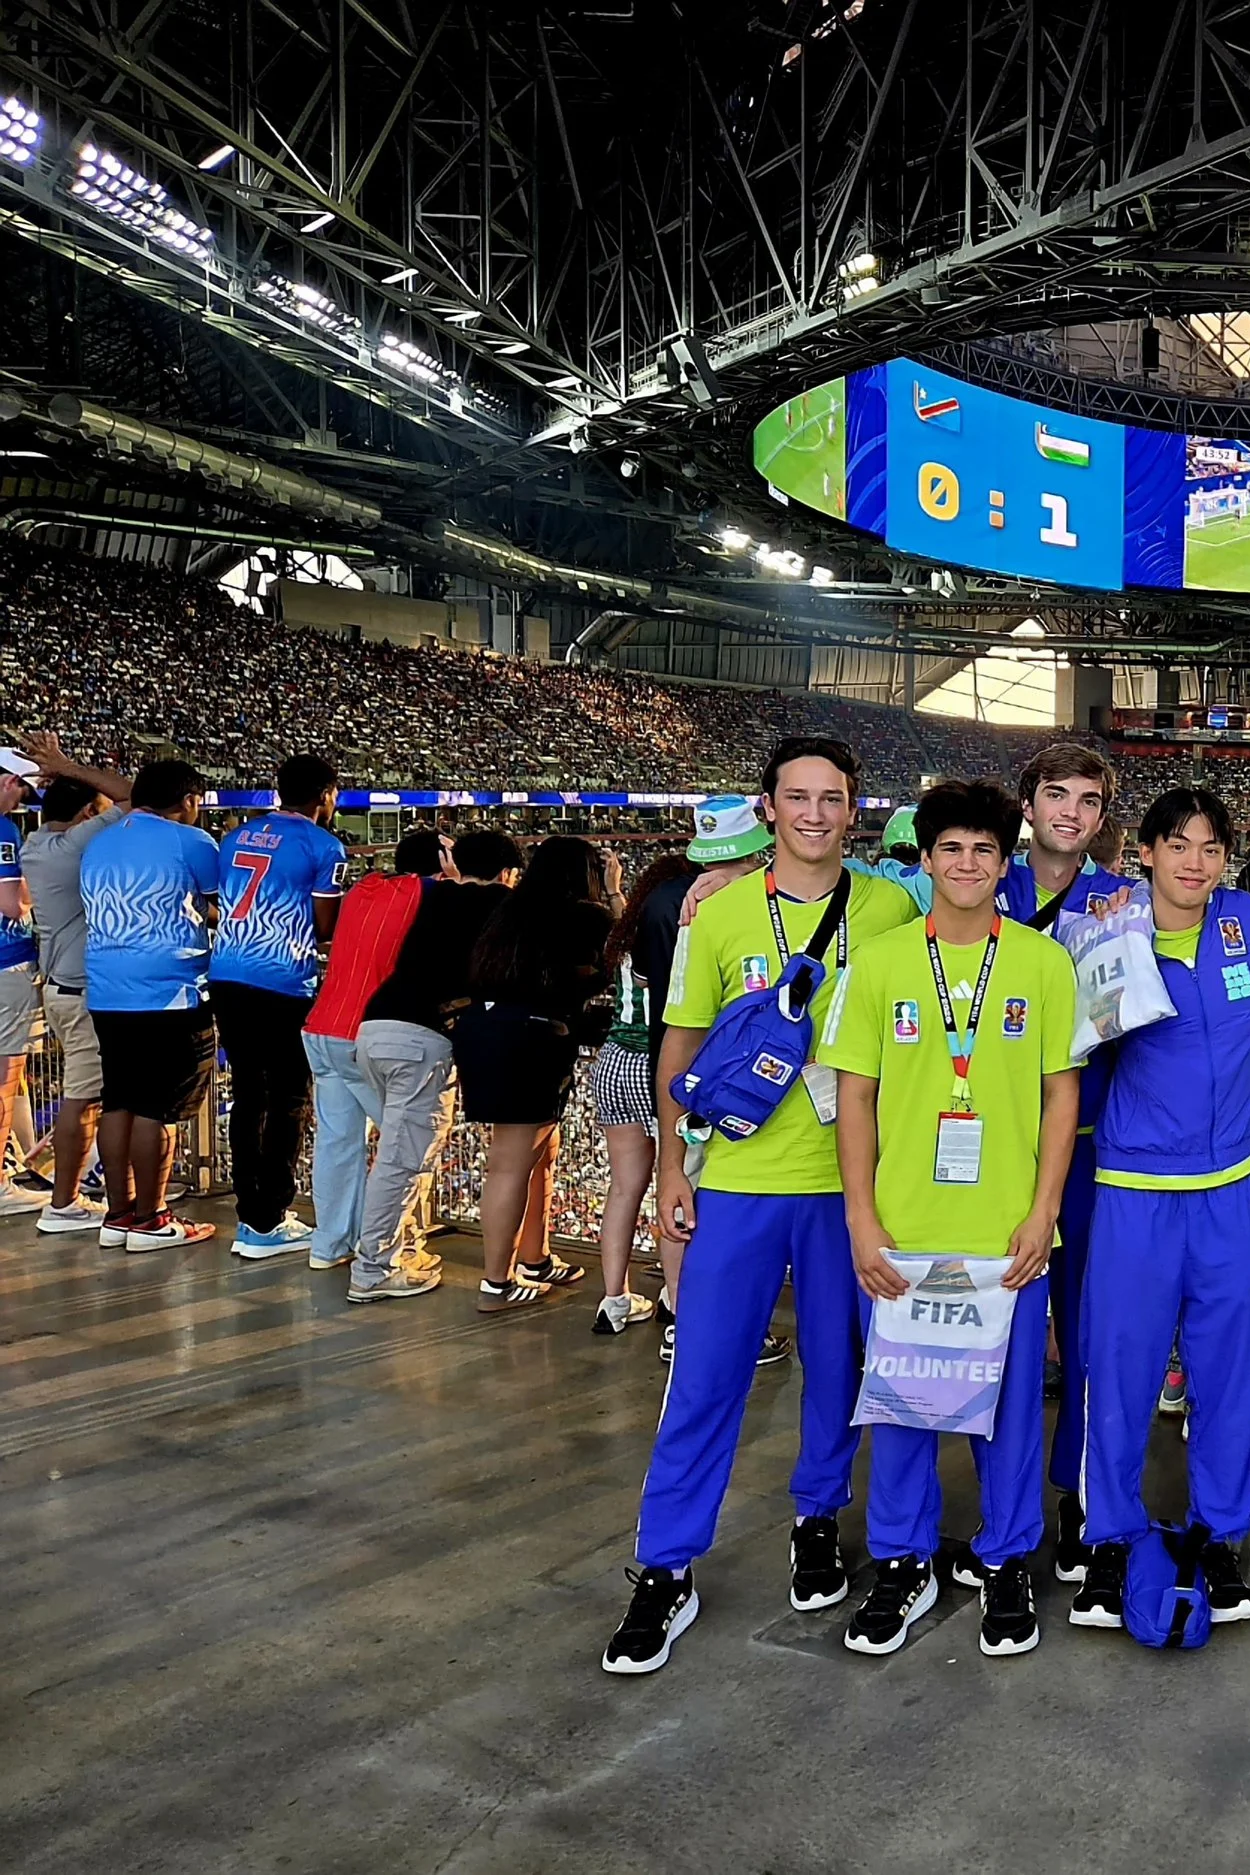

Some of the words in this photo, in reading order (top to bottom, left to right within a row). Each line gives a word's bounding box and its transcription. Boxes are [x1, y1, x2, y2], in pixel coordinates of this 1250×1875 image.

[1201, 450, 1230, 459] 43:52
[918, 461, 960, 521] 0
[1040, 492, 1077, 547] 1
[229, 851, 272, 921] 7
[772, 914, 783, 938] WORLD
[933, 958, 943, 983] WORLD
[938, 984, 946, 998] CUP
[970, 1006, 980, 1022] FIFA
[975, 980, 986, 1005] WORLD
[981, 966, 989, 980] CUP
[911, 1298, 983, 1327] FIFA
[869, 1355, 1000, 1382] VOLUNTEE
